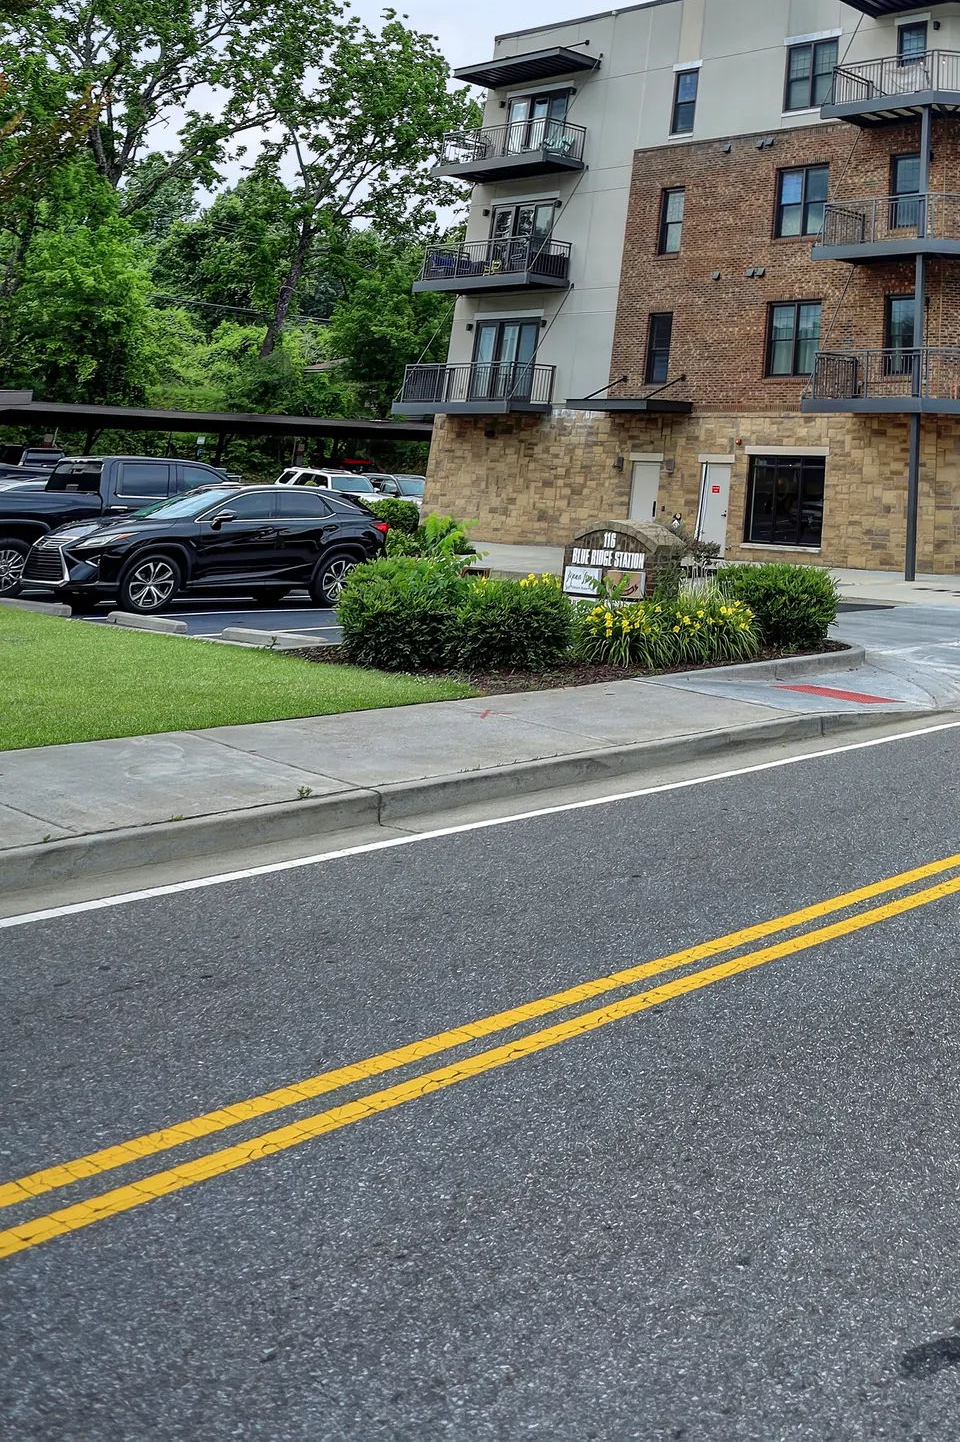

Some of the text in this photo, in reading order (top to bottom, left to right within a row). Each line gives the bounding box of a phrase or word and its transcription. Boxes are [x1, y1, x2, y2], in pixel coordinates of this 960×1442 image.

[603, 532, 616, 548] 116
[572, 548, 645, 569] BLUE RIDGE STATION
